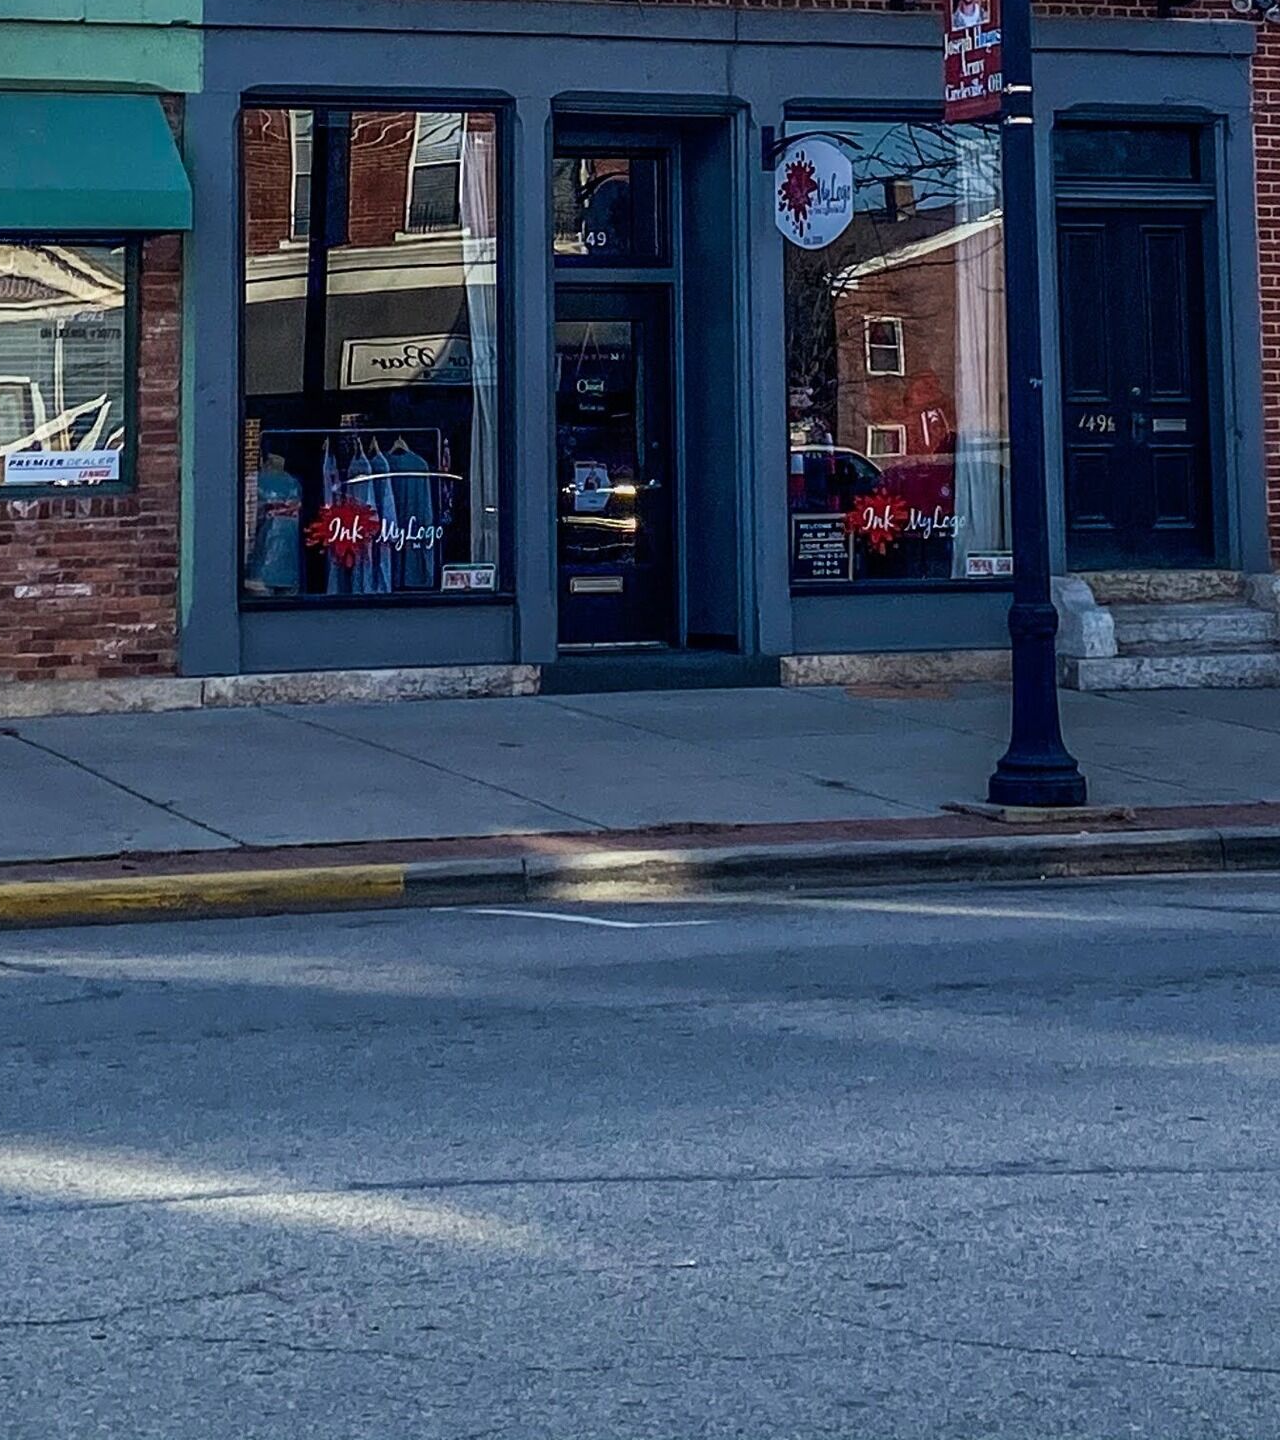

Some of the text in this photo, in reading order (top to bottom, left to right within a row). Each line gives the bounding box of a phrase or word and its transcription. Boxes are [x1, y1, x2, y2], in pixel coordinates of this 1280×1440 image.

[944, 28, 972, 60] Joseph
[960, 54, 985, 79] Army
[988, 72, 1003, 93] OH
[575, 231, 607, 246] 149
[8, 456, 116, 467] PREMIER DEALER
[328, 514, 444, 552] Ink MyLogo
[861, 505, 966, 540] Ink MyLogo
